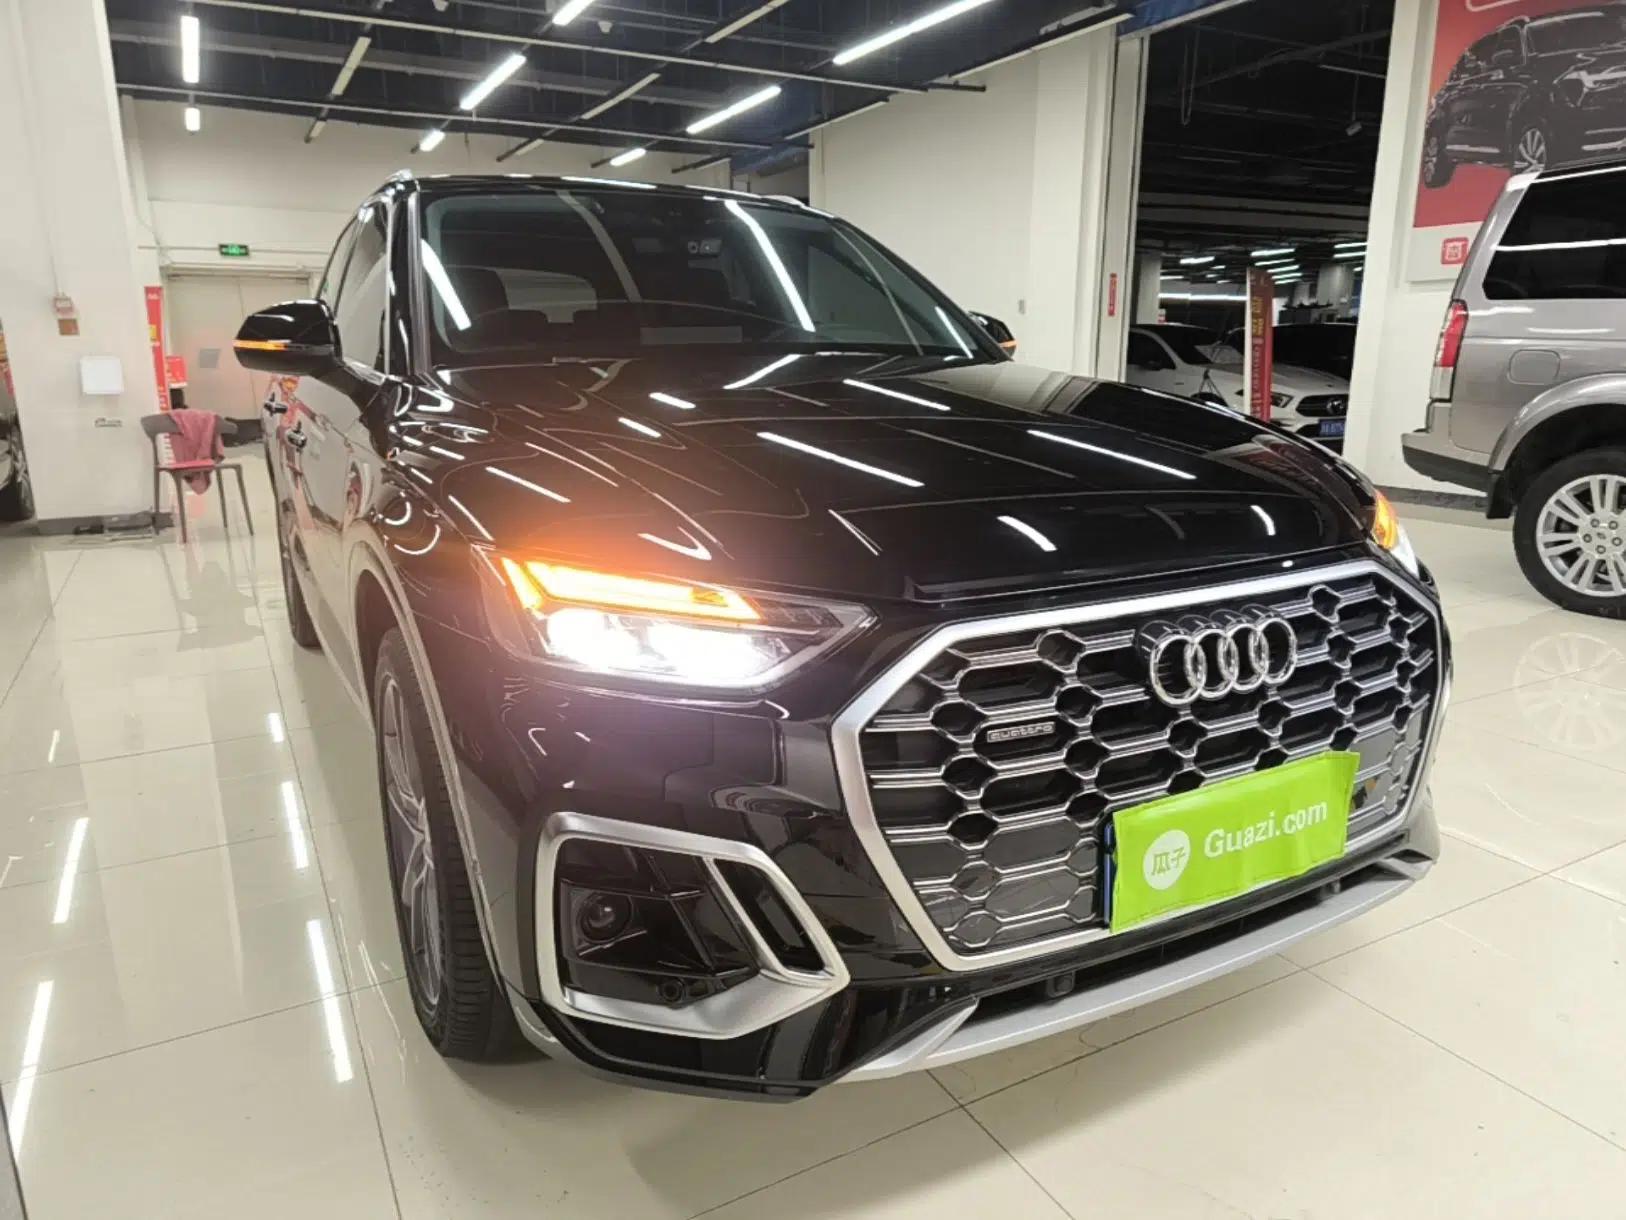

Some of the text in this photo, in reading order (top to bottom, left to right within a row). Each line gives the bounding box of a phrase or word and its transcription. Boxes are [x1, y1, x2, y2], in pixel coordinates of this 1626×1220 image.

[987, 722, 1055, 742] quattro
[1204, 801, 1328, 858] Guazi.com
[1150, 847, 1187, 876] 瓜子
